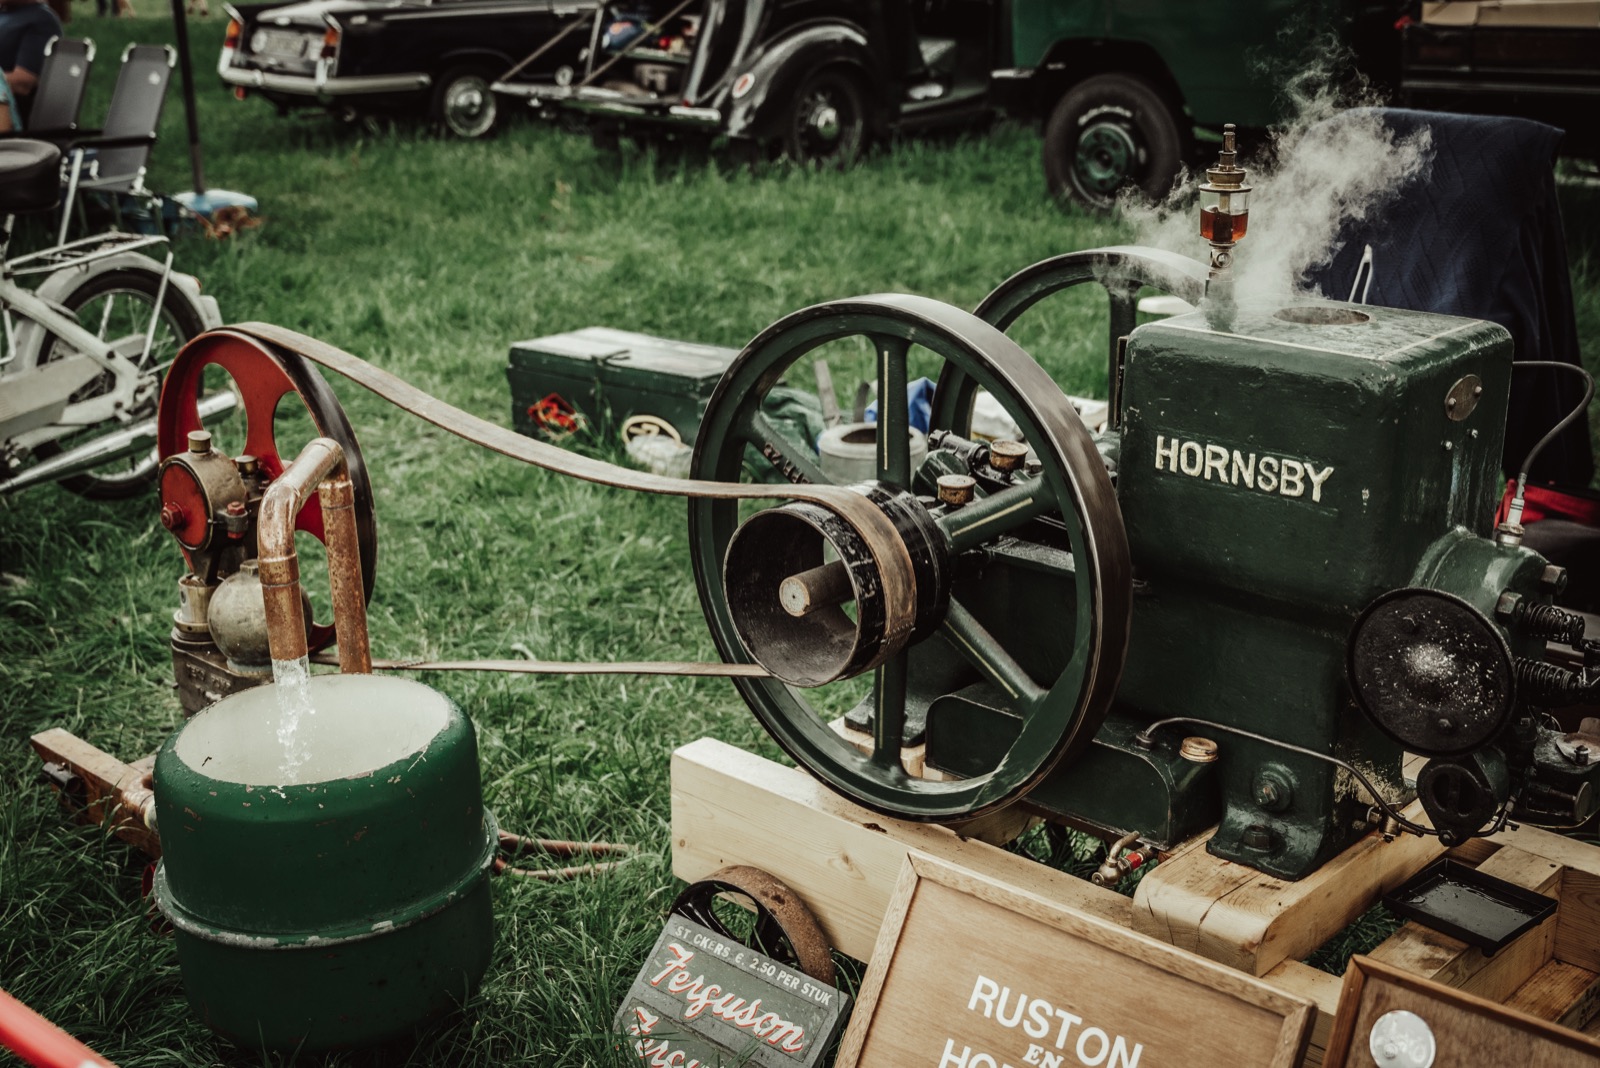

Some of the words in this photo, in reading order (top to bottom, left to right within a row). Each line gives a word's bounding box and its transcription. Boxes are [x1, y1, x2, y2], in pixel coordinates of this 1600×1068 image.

[1155, 435, 1335, 503] HORNSBY
[650, 942, 806, 1053] Ferguson
[749, 957, 776, 977] 2.50
[777, 970, 801, 990] PER
[801, 981, 833, 1006] STUK
[967, 974, 1144, 1068] RUSTON
[1022, 1043, 1065, 1068] EN
